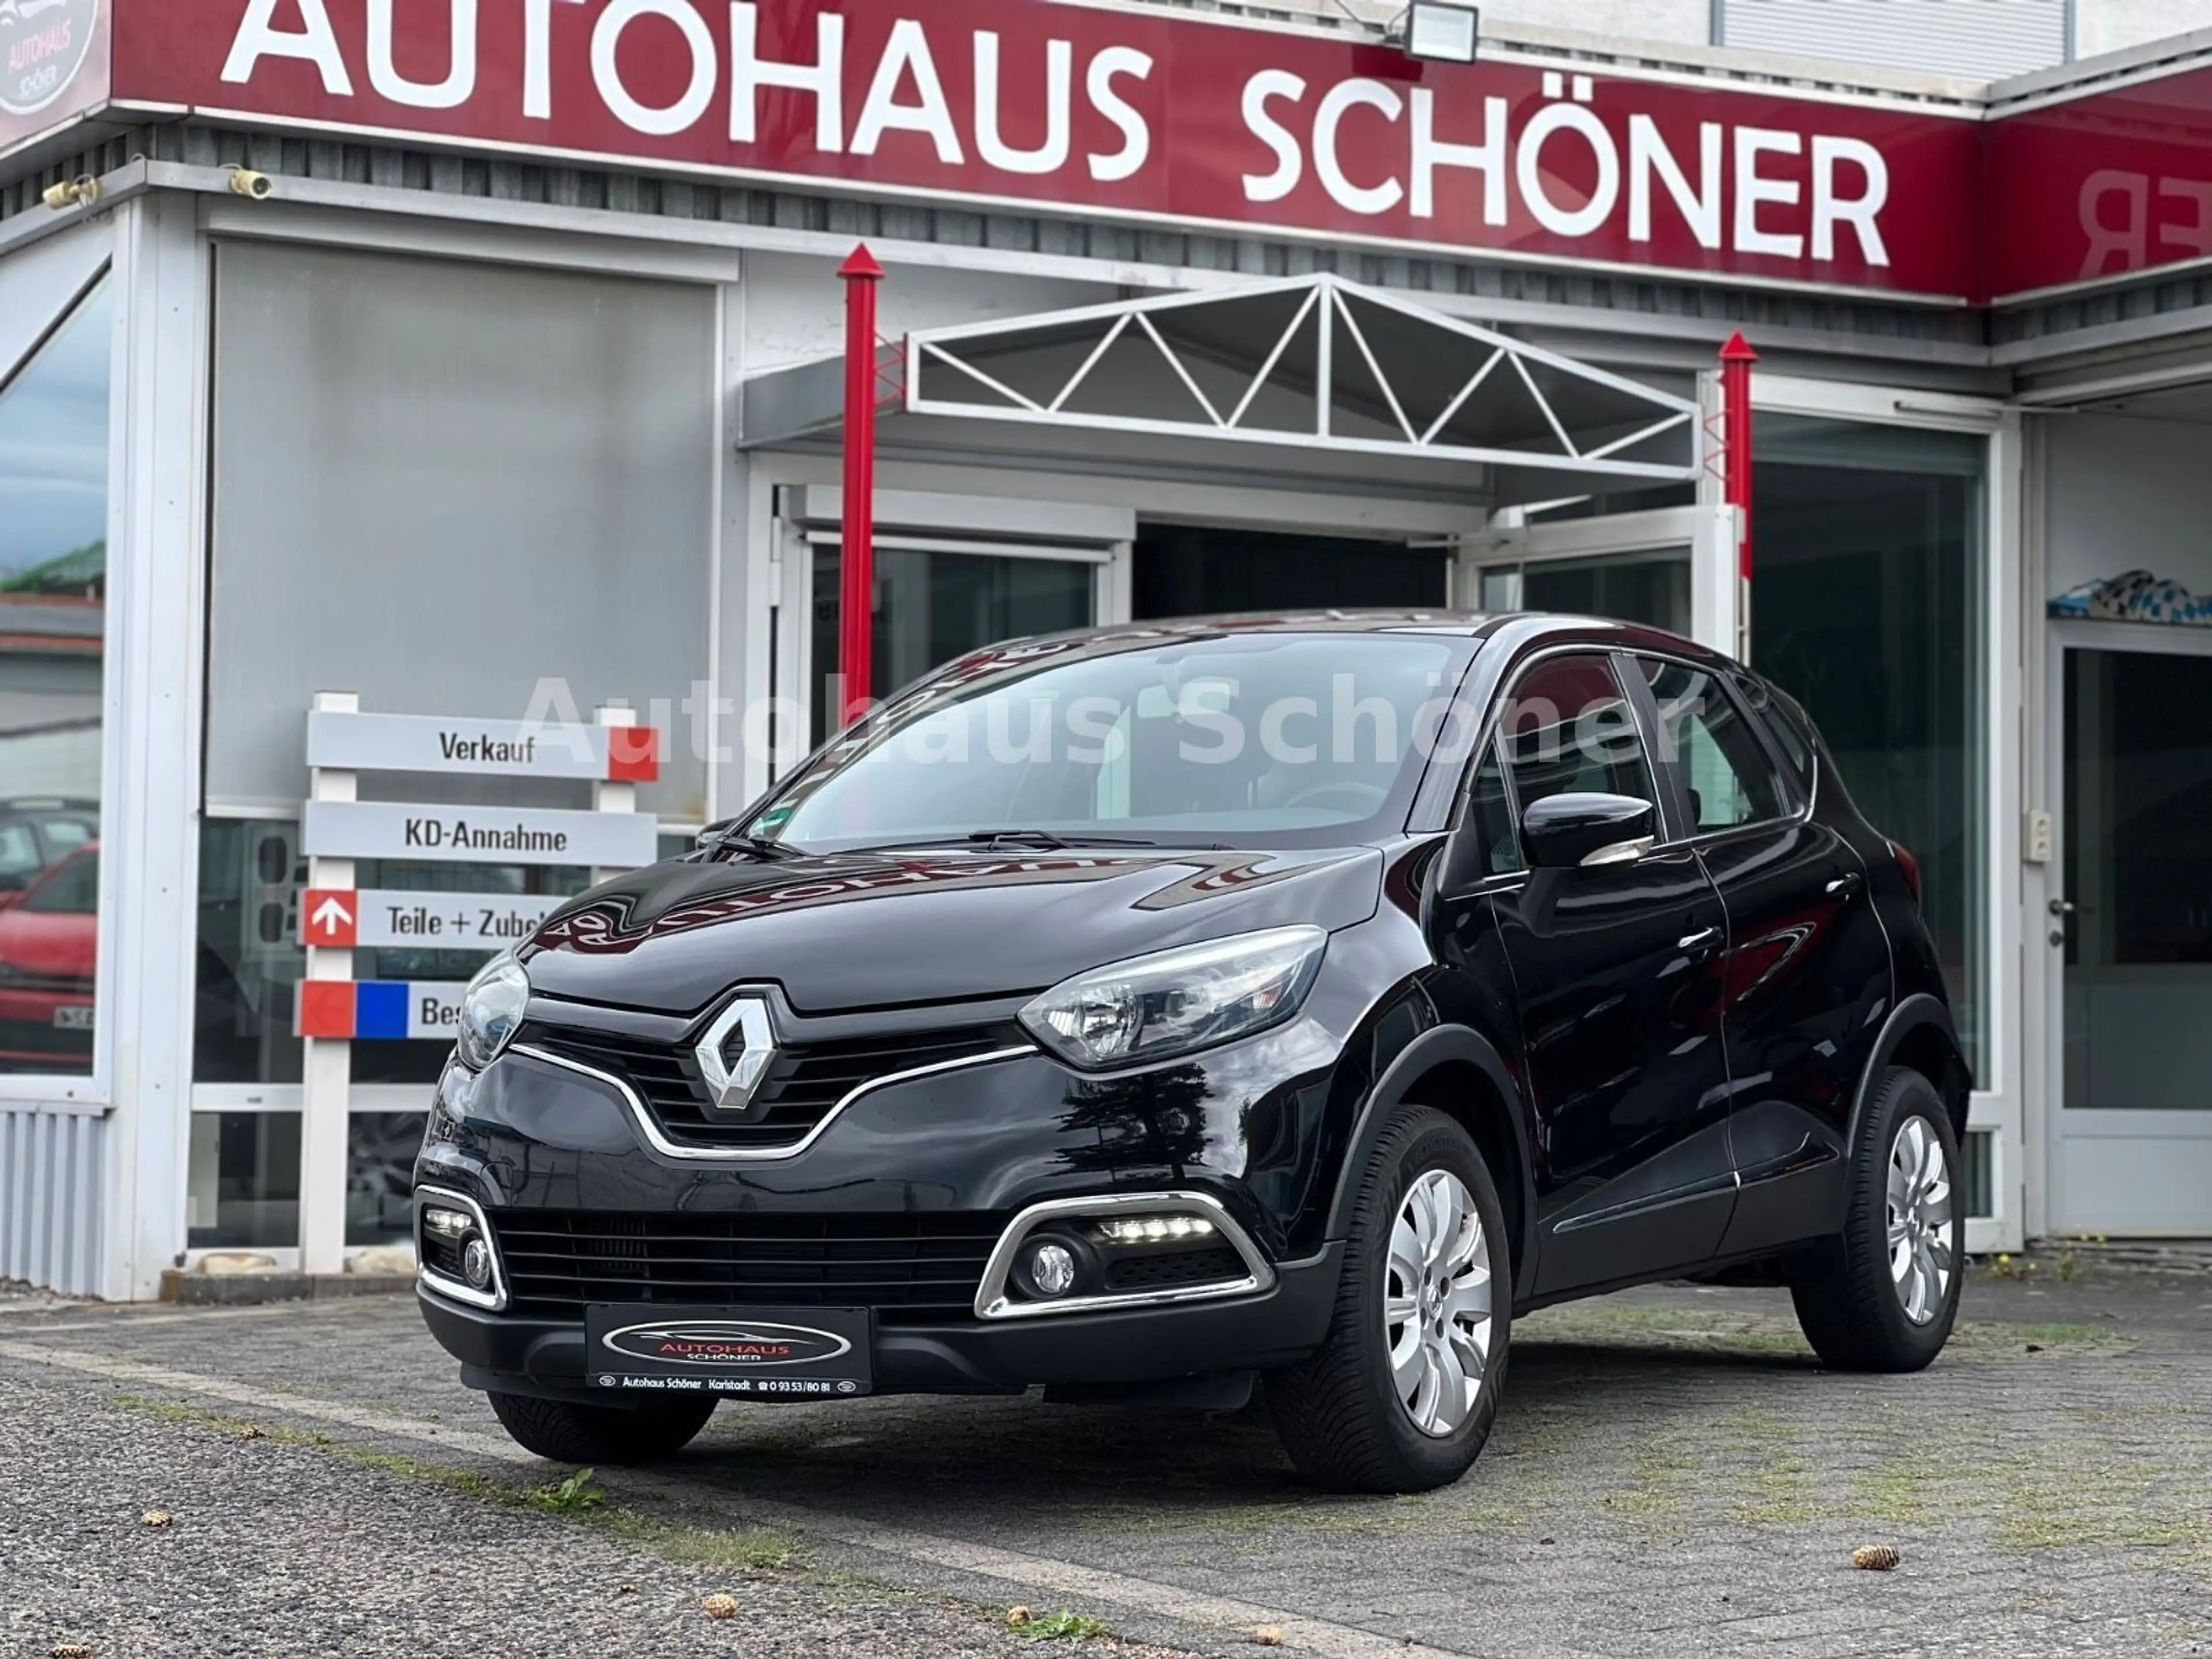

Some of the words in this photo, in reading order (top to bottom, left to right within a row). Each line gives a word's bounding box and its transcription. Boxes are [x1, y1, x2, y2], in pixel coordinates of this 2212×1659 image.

[220, 0, 1153, 180] AUTOHAUS
[1241, 69, 1891, 267] SCHÖNER
[440, 732, 536, 763] Verkauf
[406, 819, 567, 851] KD-Annahme
[387, 906, 442, 935] Teile
[450, 912, 471, 934] +
[660, 1343, 790, 1354] AUTOHAUS
[623, 1376, 665, 1388] Autohaus
[666, 1377, 702, 1389] Schöner
[709, 1379, 751, 1391] Karlstadt
